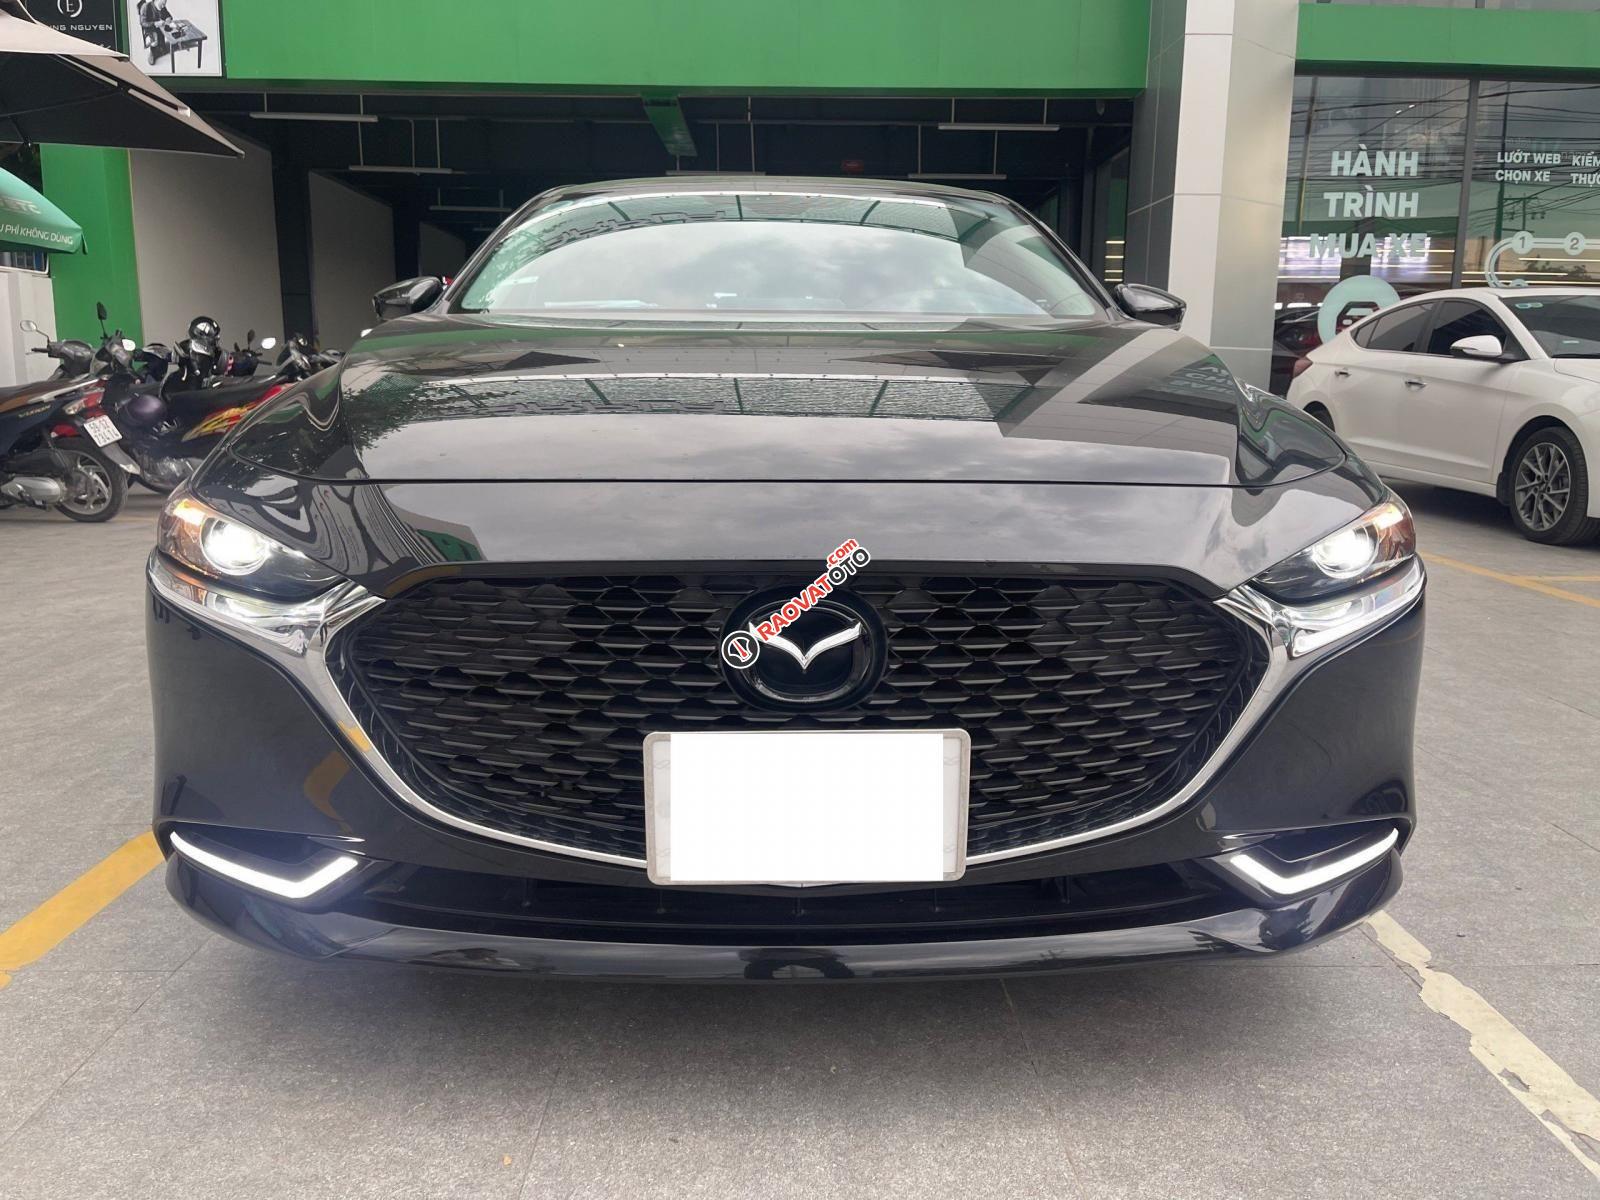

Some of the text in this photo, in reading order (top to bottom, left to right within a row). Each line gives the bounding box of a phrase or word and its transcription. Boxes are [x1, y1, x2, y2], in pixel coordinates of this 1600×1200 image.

[1330, 143, 1419, 176] HÀNH
[1497, 149, 1531, 163] LƯỚT
[1533, 153, 1561, 164] WEB
[1495, 169, 1551, 184] CHỌN XE
[1323, 184, 1419, 218] TRÌNH
[20, 227, 49, 240] KHÔNG
[1310, 233, 1428, 259] MUA XE
[1520, 236, 1526, 249] 1
[1569, 237, 1580, 250] 2
